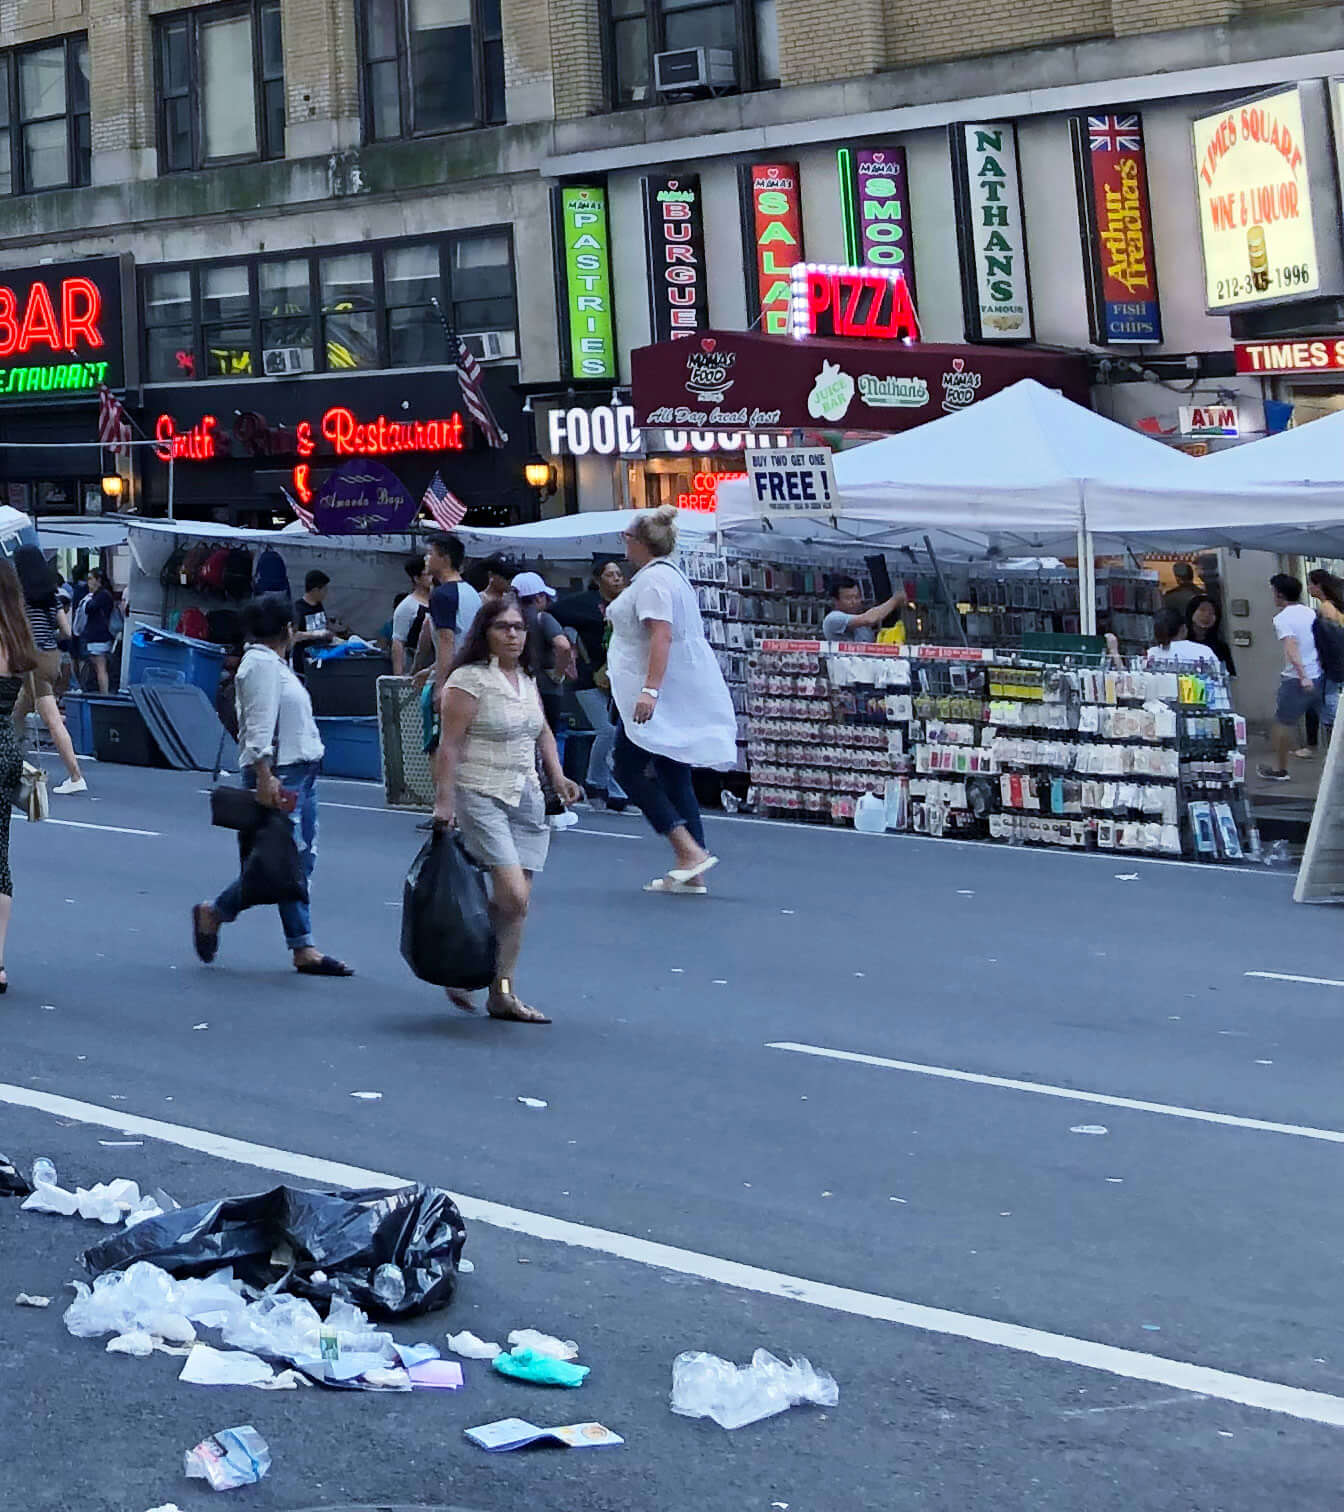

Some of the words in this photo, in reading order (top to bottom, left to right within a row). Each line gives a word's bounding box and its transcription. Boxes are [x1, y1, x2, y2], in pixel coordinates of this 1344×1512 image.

[1200, 114, 1236, 186] TIMES
[1240, 108, 1302, 181] SQUARE
[974, 130, 1015, 302] NATHAN'S
[1210, 193, 1237, 231] WINE
[1251, 181, 1299, 225] LIQUOR
[1114, 157, 1150, 289] Treacher's
[1101, 183, 1137, 295] Arthur
[663, 203, 698, 341] BURGUE
[573, 213, 606, 375] PASTRIES
[807, 273, 918, 340] PIZZA
[981, 304, 1024, 314] FAMOUS
[1113, 303, 1146, 315] FISH
[1109, 321, 1153, 333] CHIPS
[1246, 342, 1329, 370] TIMES
[691, 368, 726, 384] FOOD
[859, 375, 927, 398] Nathan's
[814, 379, 847, 404] JUICE
[822, 392, 847, 413] BAR
[946, 388, 975, 403] FOOD
[647, 406, 673, 423] All
[674, 406, 707, 427] Day
[709, 406, 747, 423] break
[749, 407, 781, 428] fast
[1192, 408, 1235, 426] ATM
[322, 405, 464, 457] Restaurant
[548, 405, 641, 456] FOOD
[752, 455, 767, 467] BUY
[771, 454, 788, 466] TWO
[791, 454, 805, 466] GET
[809, 453, 826, 465] ONE
